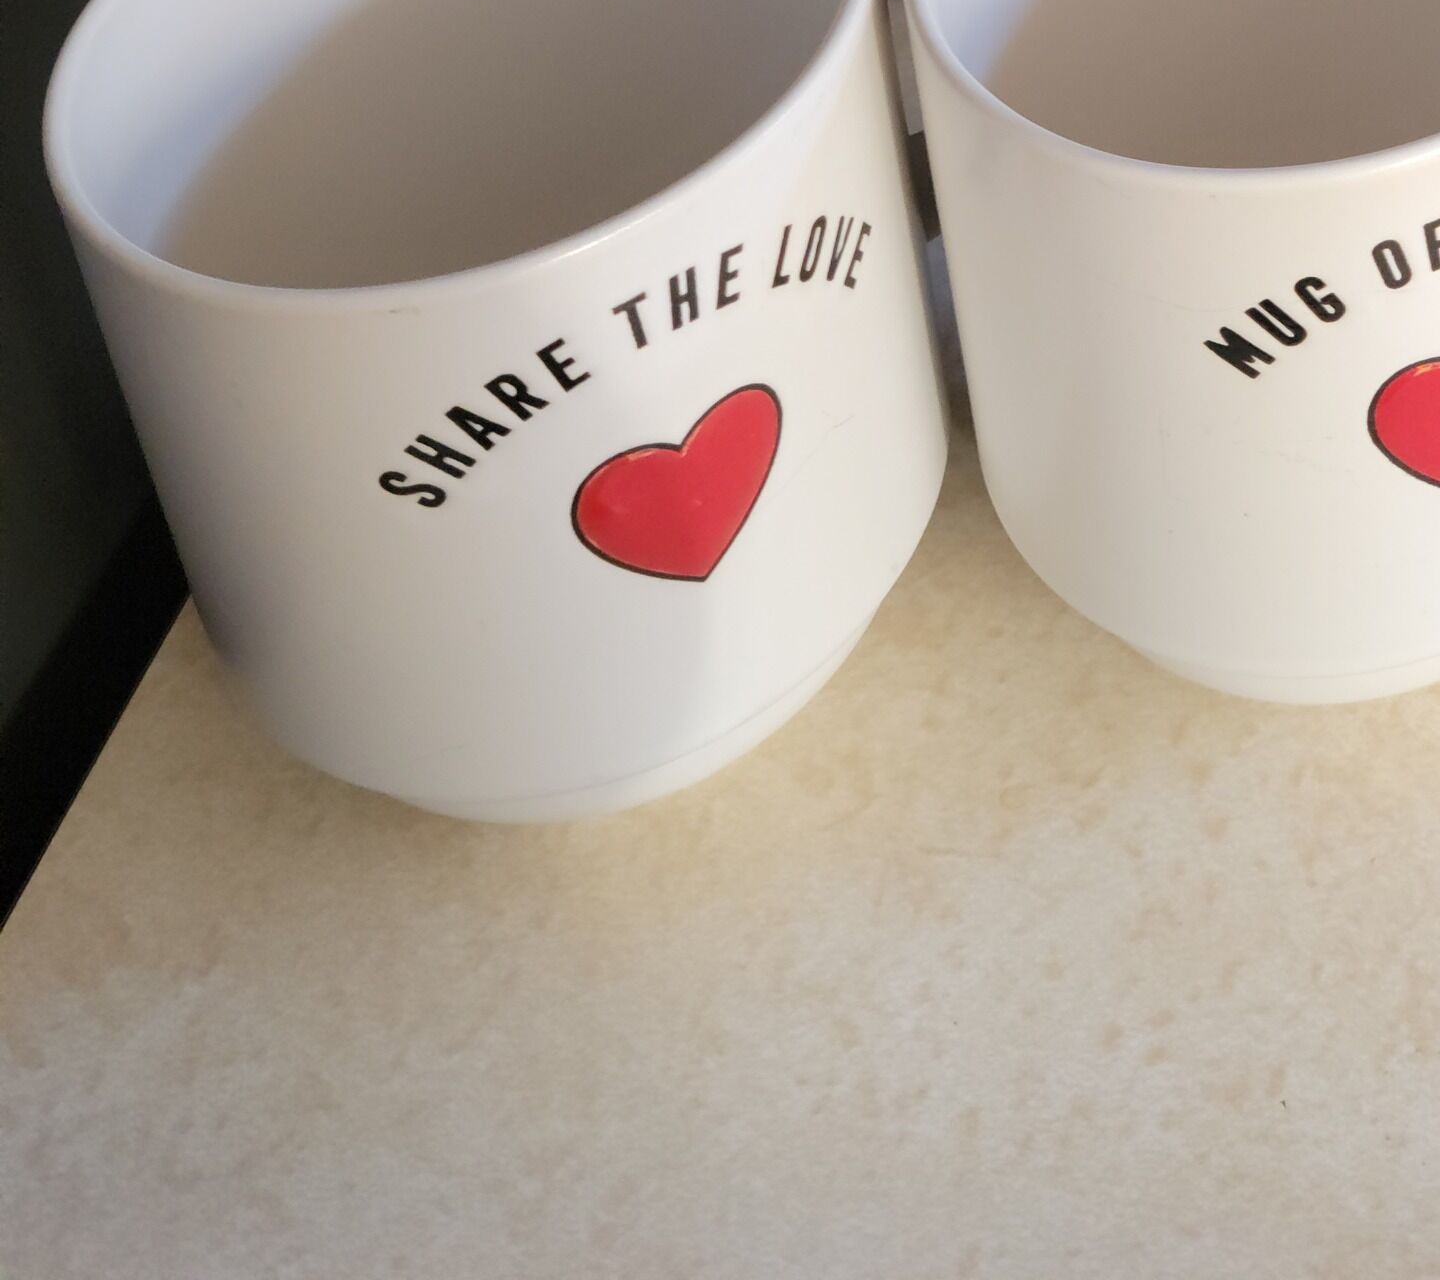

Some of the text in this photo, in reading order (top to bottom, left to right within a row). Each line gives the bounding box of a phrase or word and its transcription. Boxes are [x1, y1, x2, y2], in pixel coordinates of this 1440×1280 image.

[378, 214, 872, 509] SHARE THE LOVE
[1202, 276, 1346, 379] MUG
